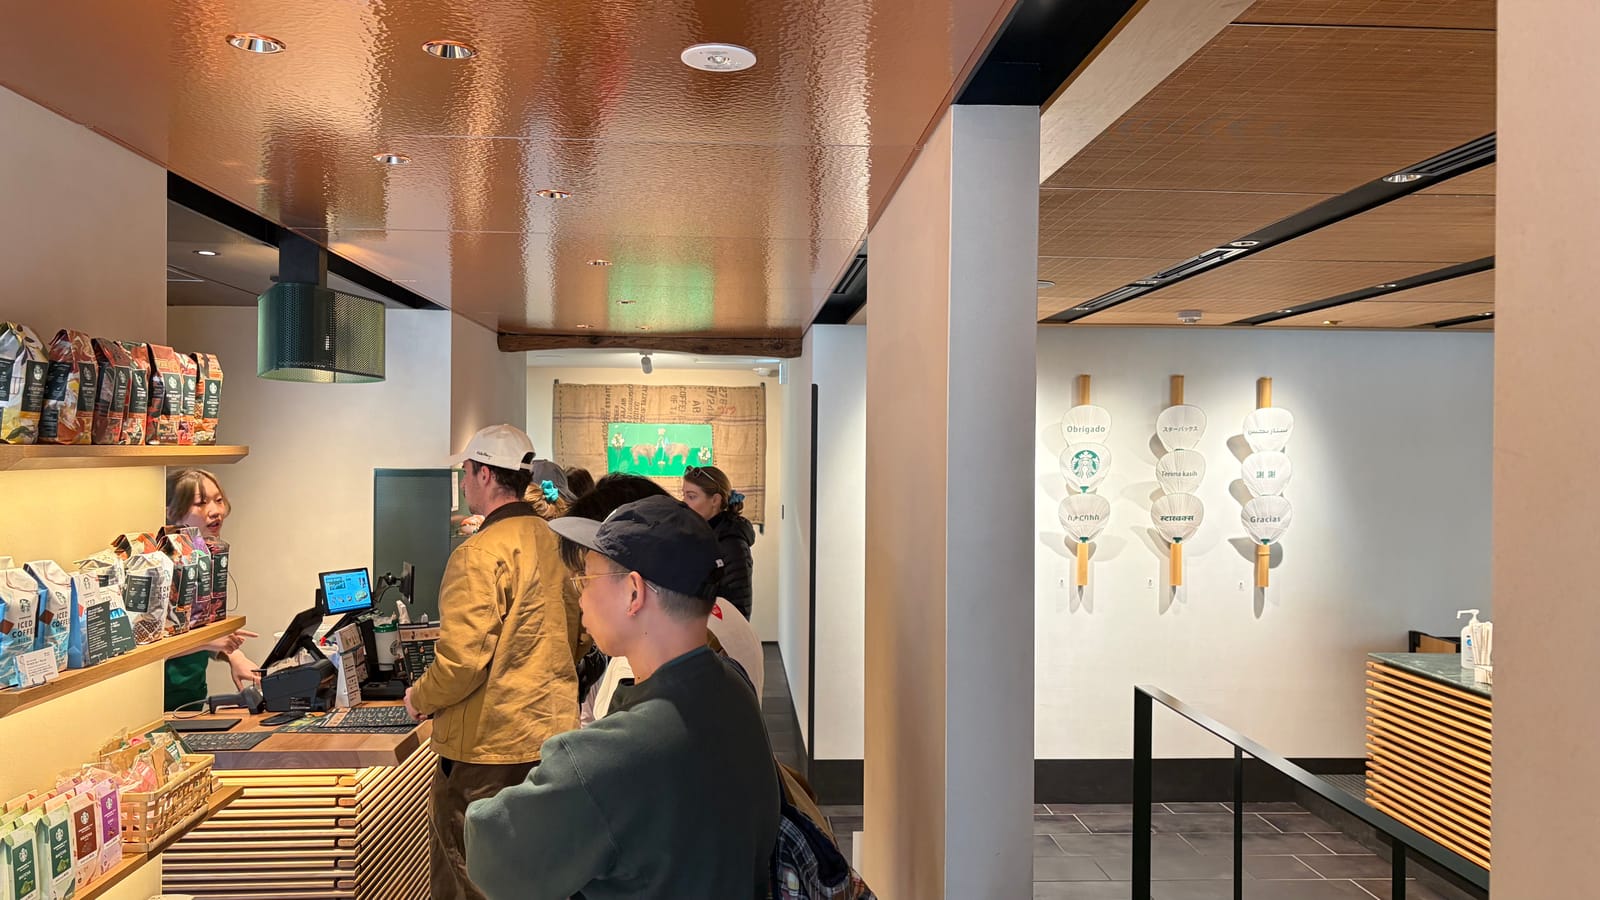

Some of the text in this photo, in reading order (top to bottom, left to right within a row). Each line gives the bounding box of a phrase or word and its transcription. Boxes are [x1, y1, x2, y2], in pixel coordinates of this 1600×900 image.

[1066, 425, 1106, 434] Obrigado
[1250, 515, 1281, 524] Gracias
[56, 611, 68, 620] ICED
[17, 620, 33, 630] ICED
[51, 619, 68, 628] COFFE
[11, 628, 33, 638] COFFE
